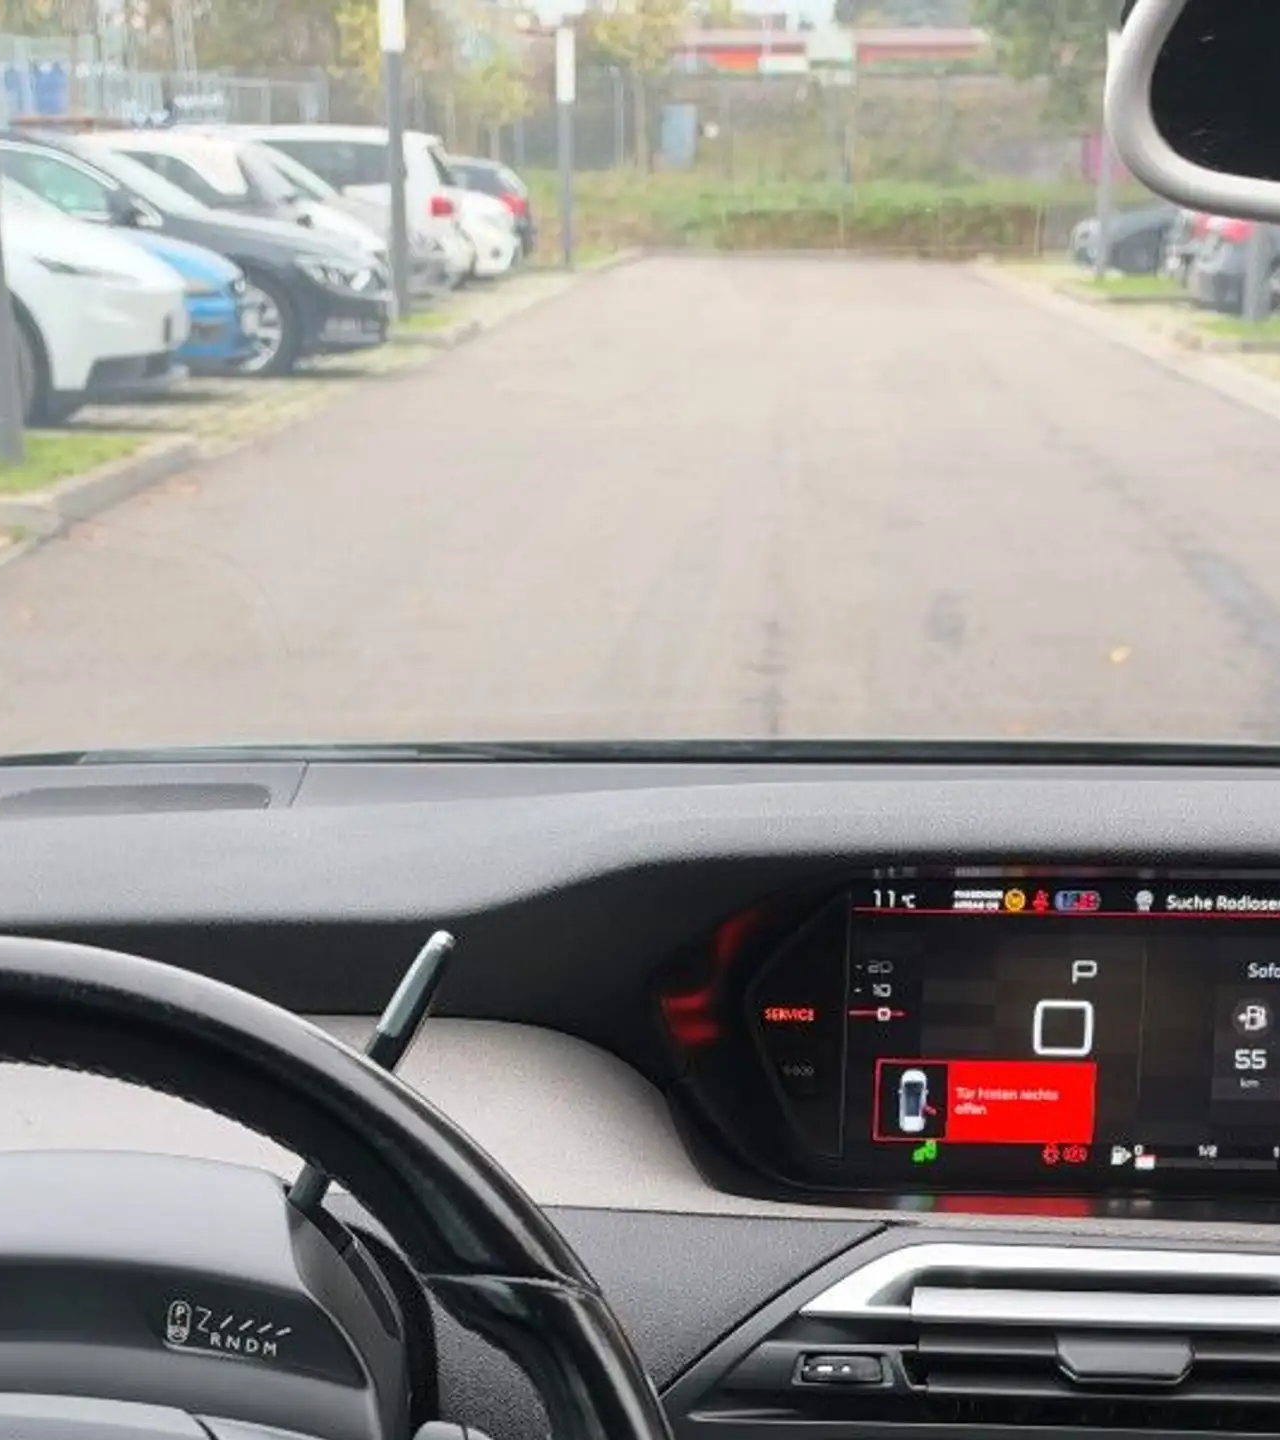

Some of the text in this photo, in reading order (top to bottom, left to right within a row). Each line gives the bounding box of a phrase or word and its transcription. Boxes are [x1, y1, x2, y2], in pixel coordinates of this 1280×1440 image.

[1166, 894, 1214, 911] Suche
[1071, 960, 1098, 985] P
[764, 1007, 815, 1022] SERVICE
[1234, 1049, 1267, 1070] 55
[1239, 1077, 1260, 1089] km
